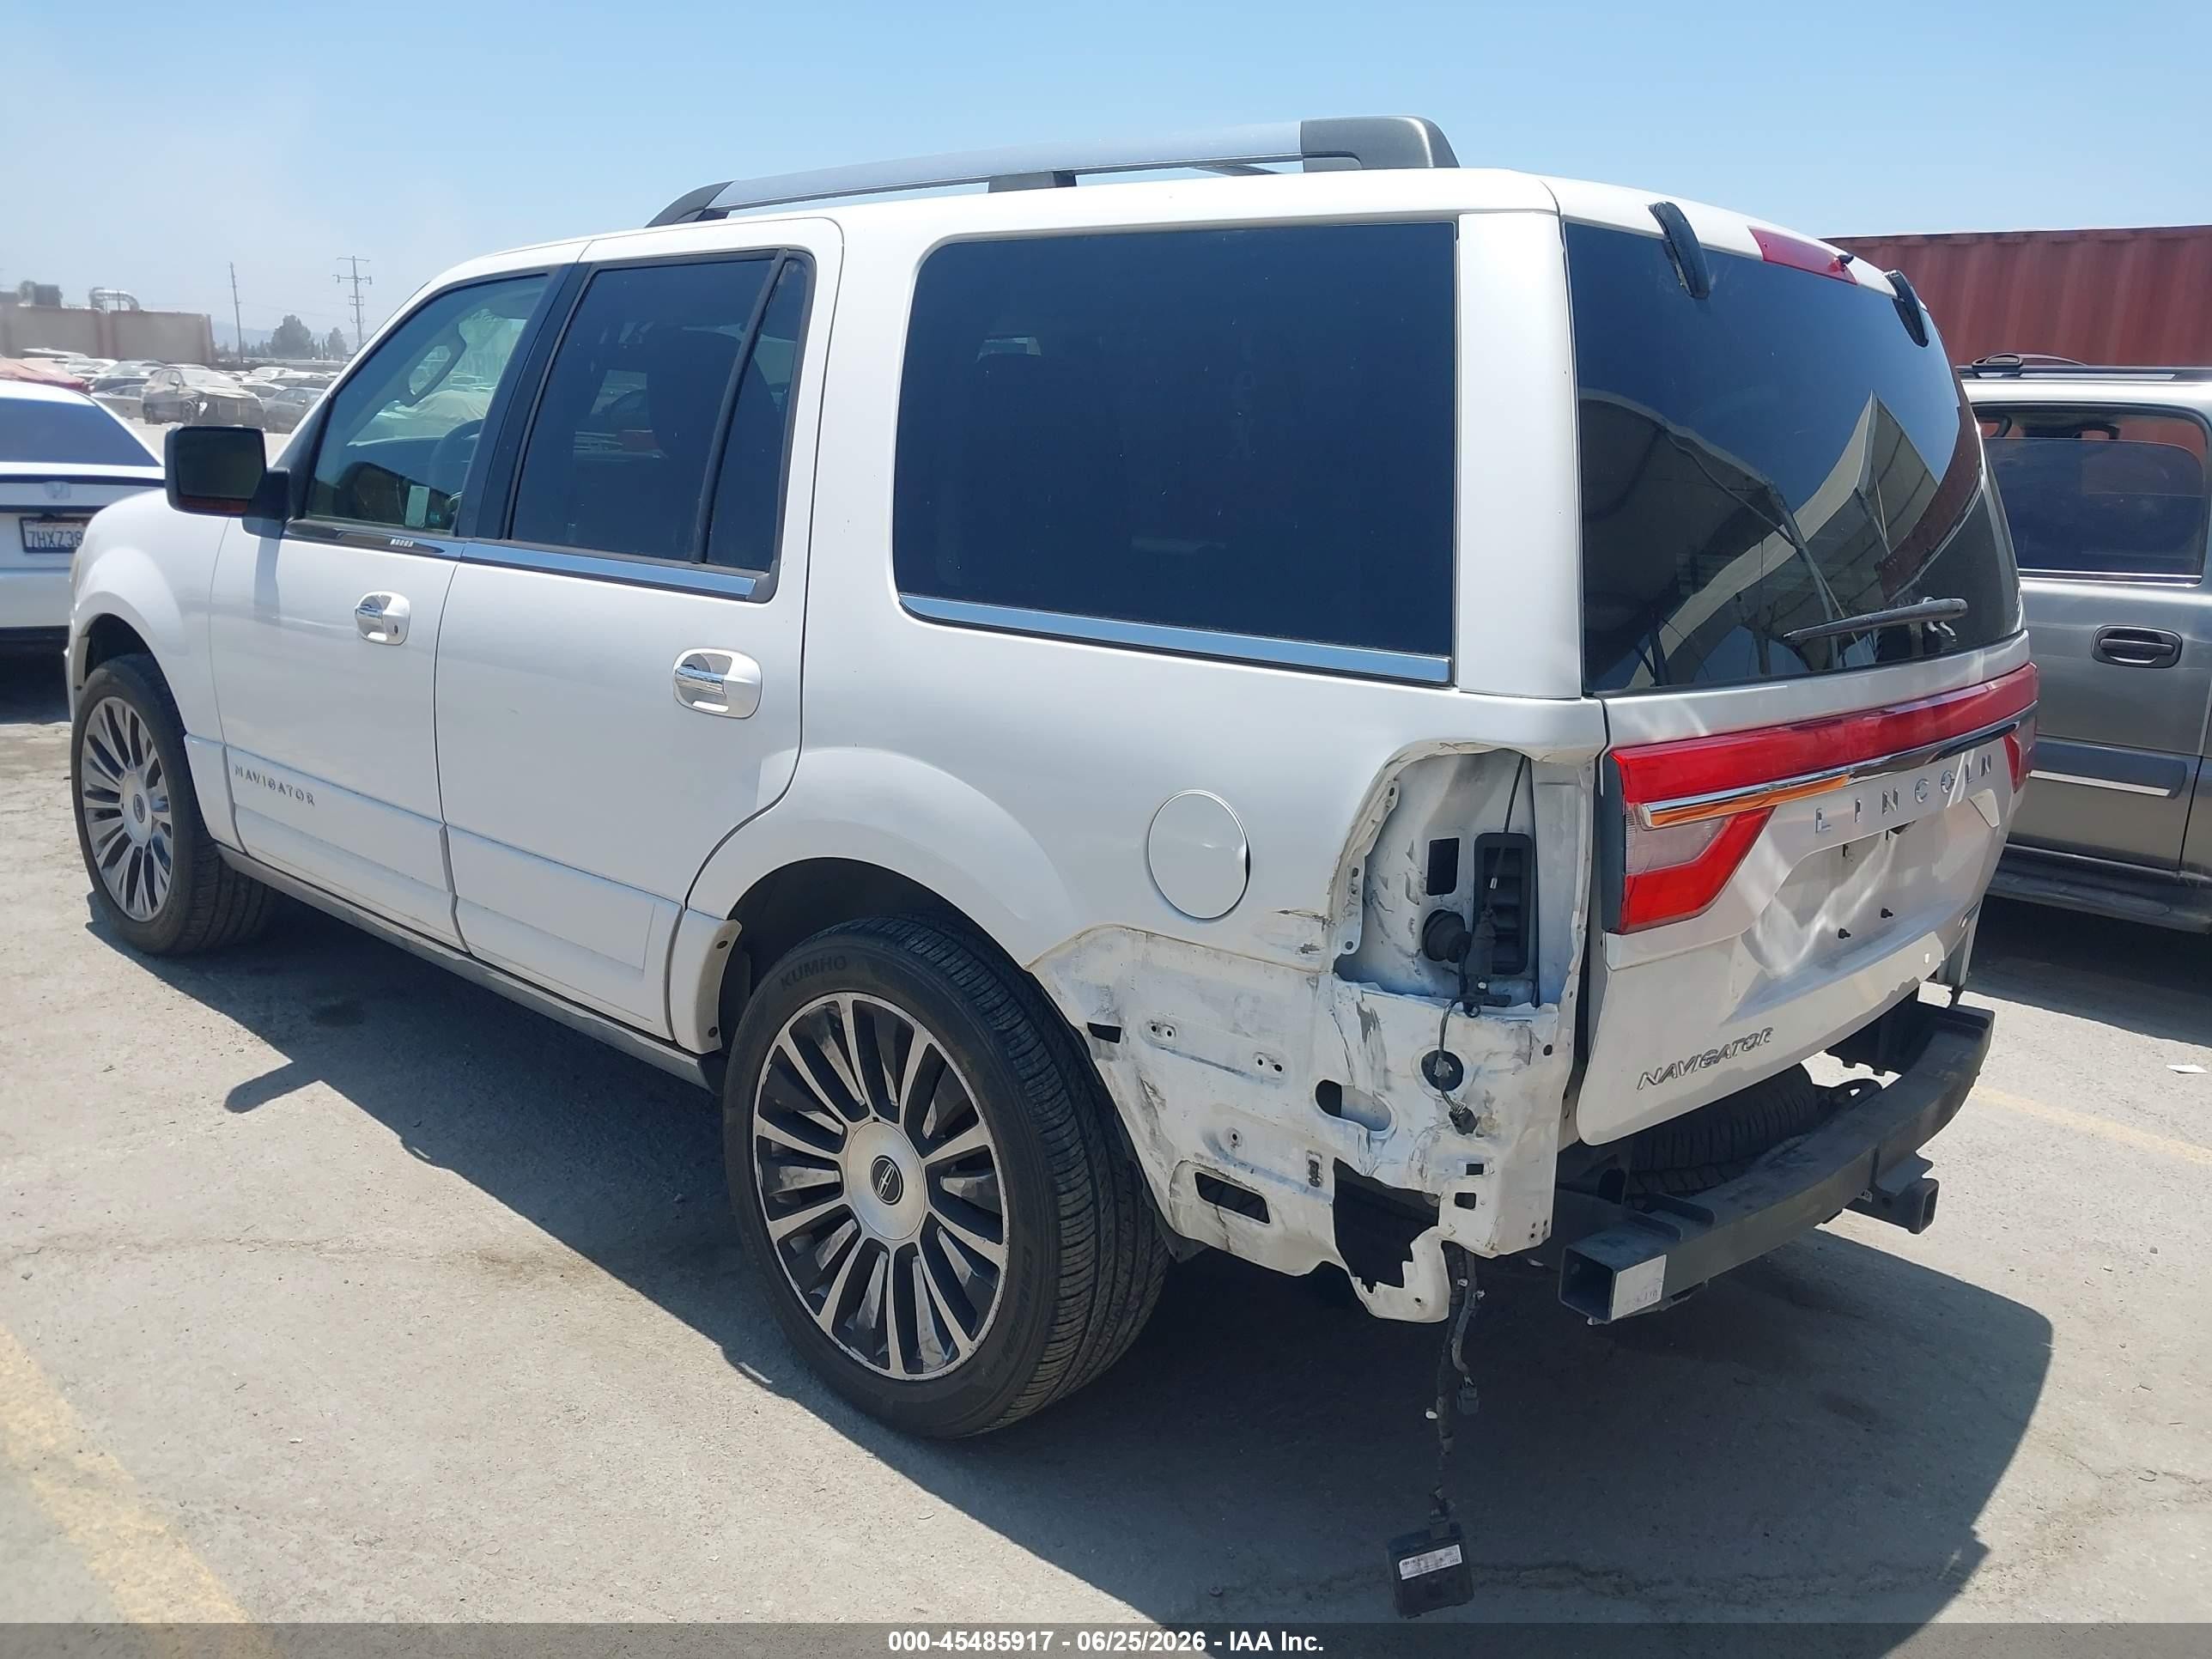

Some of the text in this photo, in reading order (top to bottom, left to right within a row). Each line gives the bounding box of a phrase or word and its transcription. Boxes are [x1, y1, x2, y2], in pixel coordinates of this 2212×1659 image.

[27, 531, 83, 548] 7HXZ38
[234, 763, 316, 807] NAVIGATOR
[1815, 755, 1992, 834] LINCOLN
[781, 955, 847, 991] KUMHO
[1637, 1027, 1774, 1091] NAVIGATOR
